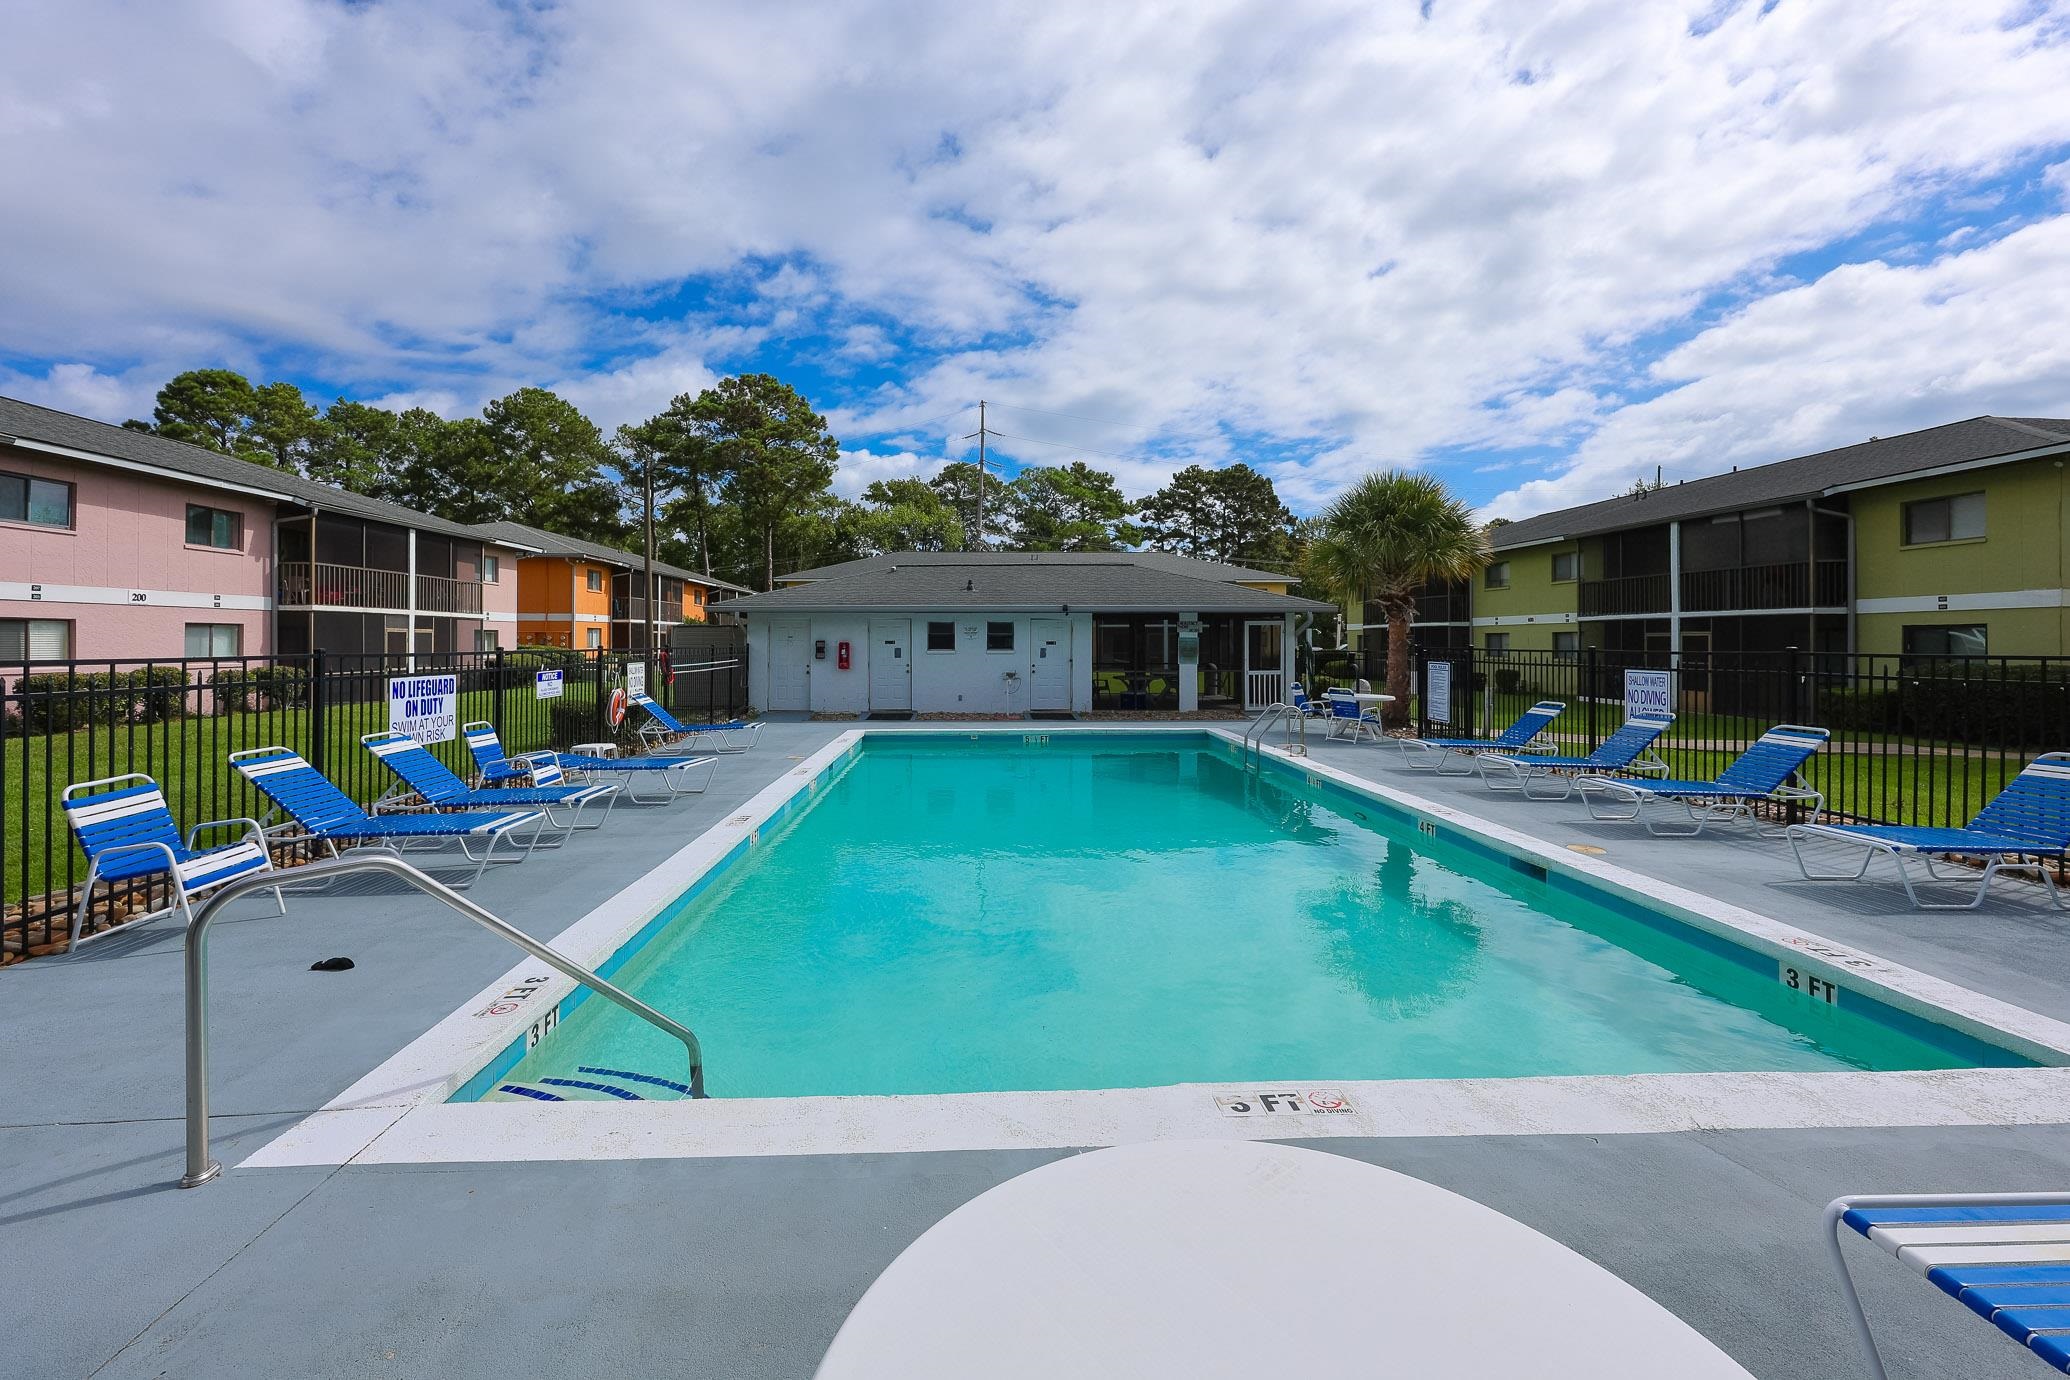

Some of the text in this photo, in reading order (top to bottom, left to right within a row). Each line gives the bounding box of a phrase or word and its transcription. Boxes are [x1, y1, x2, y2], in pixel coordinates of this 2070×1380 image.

[132, 593, 147, 602] 200
[542, 672, 558, 681] NOTICE
[1629, 675, 1666, 688] SHALLOW WATER
[392, 678, 455, 700] NO LIFEGUARD
[1628, 689, 1667, 706] NO DIVING
[405, 697, 444, 718] ON DUTY
[391, 714, 454, 733] SWIM AT YOUR
[426, 727, 447, 742] RISK
[1040, 735, 1049, 743] FT
[1420, 821, 1435, 837] 4 FT
[503, 976, 550, 1000] 3 FT
[1786, 967, 1836, 1004] 3 FT
[531, 1003, 559, 1048] 3 FT
[1258, 1093, 1301, 1113] FT
